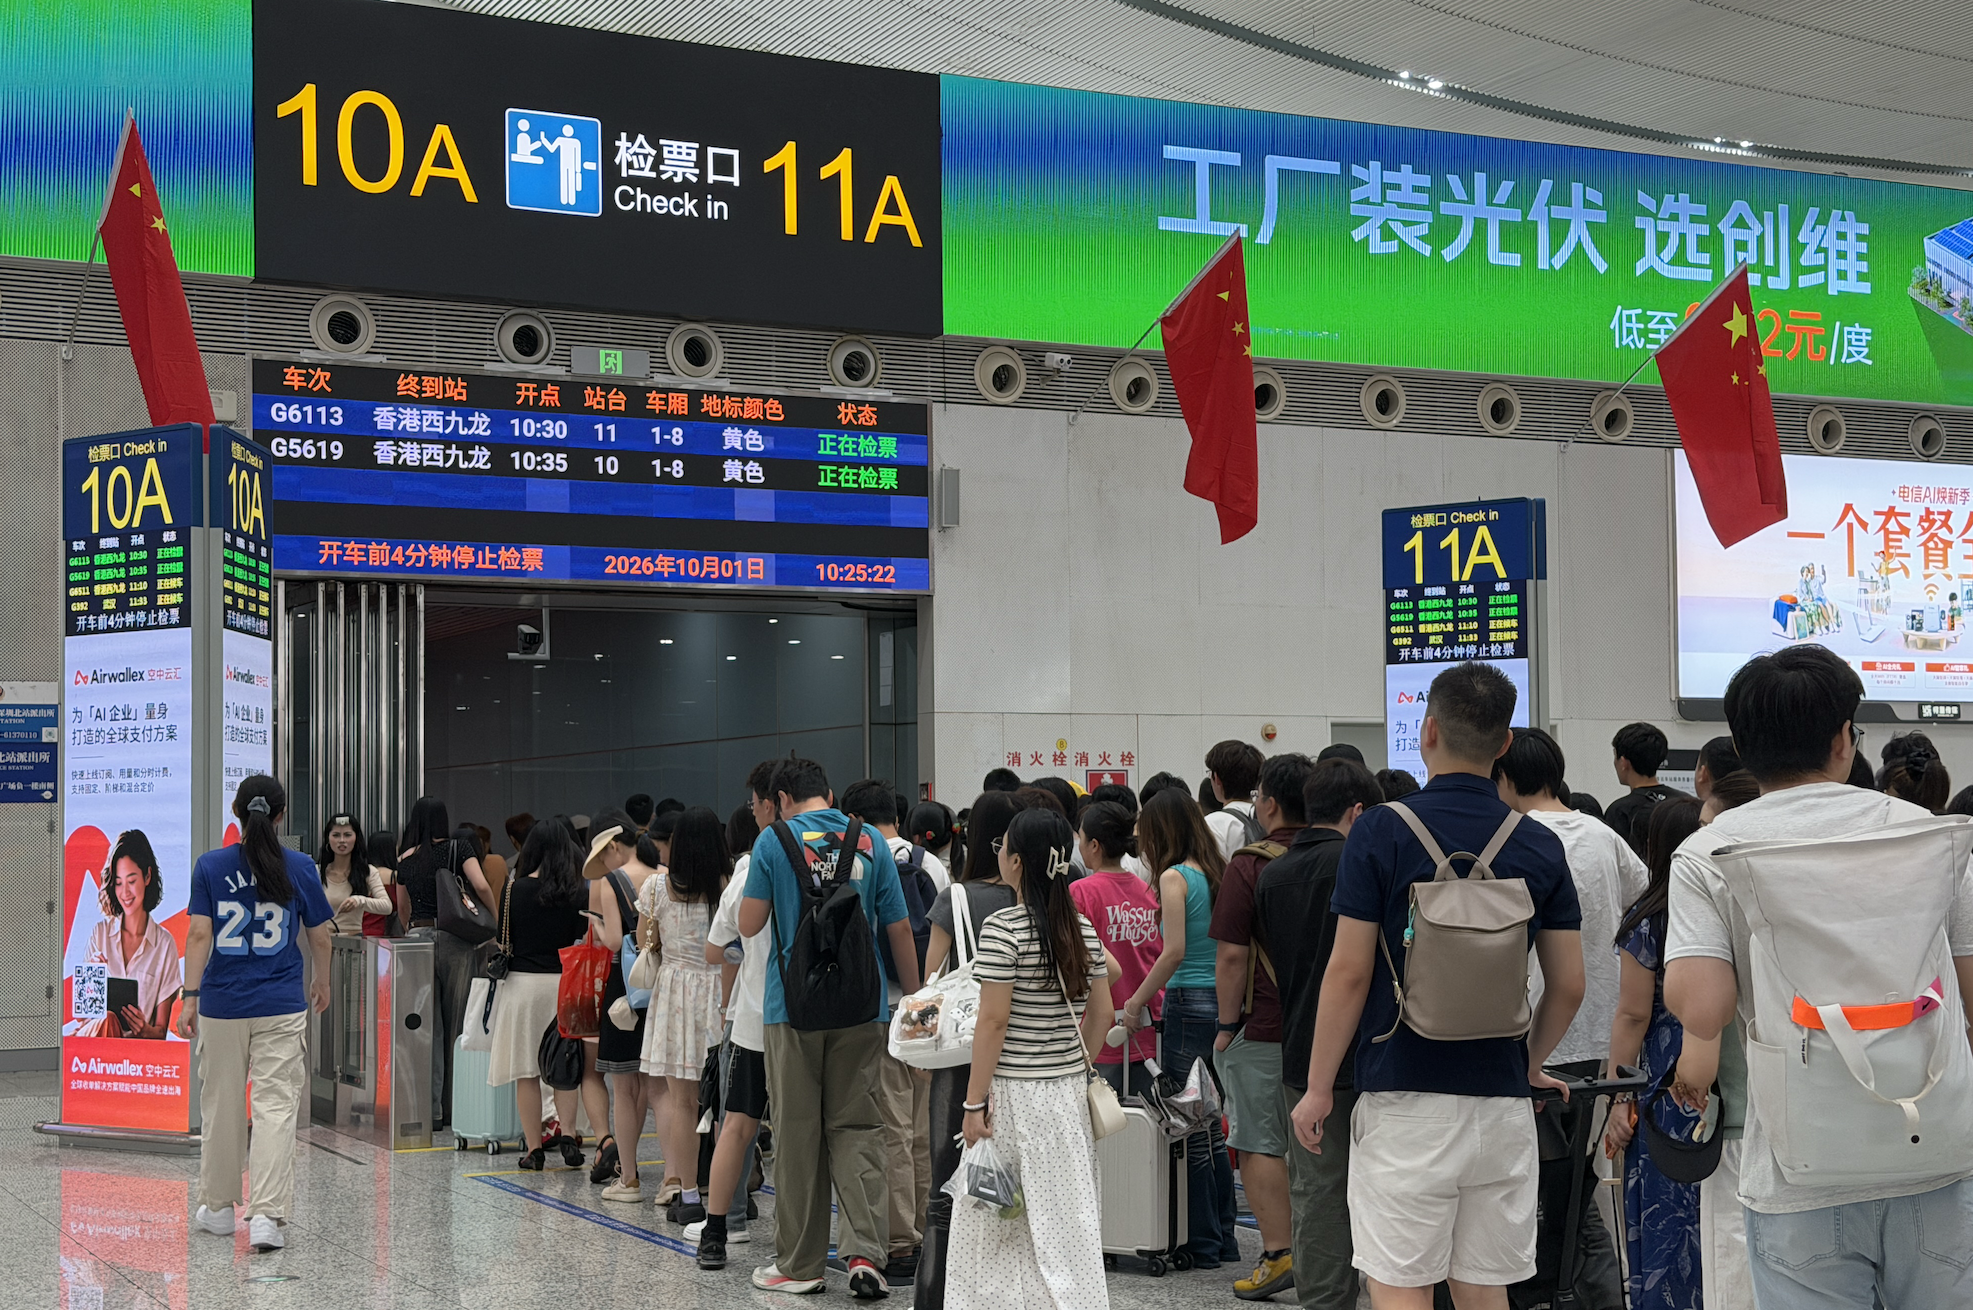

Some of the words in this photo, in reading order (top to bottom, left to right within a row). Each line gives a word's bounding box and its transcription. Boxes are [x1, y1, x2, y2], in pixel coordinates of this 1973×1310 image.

[277, 83, 479, 204] 10A
[614, 132, 740, 186] 检票口
[614, 184, 699, 218] Check
[706, 194, 729, 220] in
[763, 140, 923, 248] 11A
[1158, 143, 1608, 275] 工厂装光伏
[1634, 188, 1873, 297] 选创维
[283, 366, 332, 393] 车次
[397, 374, 468, 401] 终到站
[516, 383, 561, 408] 开点
[584, 386, 627, 412] 站台
[646, 390, 689, 415] 车厢
[700, 394, 785, 421] 地标颜色
[837, 402, 878, 426] 状态
[270, 403, 344, 426] G6113
[373, 406, 492, 437] 香港西九龙
[510, 418, 568, 440] 10:30
[594, 422, 617, 442] 11
[651, 426, 684, 446] 1-8
[722, 427, 764, 452] 黄色
[818, 433, 898, 459] 正在检票
[88, 444, 121, 463] 检票口
[123, 440, 155, 457] Check
[158, 438, 167, 452] in
[271, 437, 344, 460] G5619
[373, 440, 492, 471] 香港西九龙
[510, 451, 568, 473] 10:35
[595, 456, 619, 475] 10
[651, 459, 685, 479] 1-8
[723, 460, 765, 484] 黄色
[818, 465, 898, 490] 正在检票
[82, 457, 174, 534] 10A
[228, 462, 266, 540] 10A
[1411, 513, 1447, 528] 检票口
[1450, 510, 1486, 524] Check
[1489, 509, 1498, 521] in
[72, 541, 86, 551] 车次
[130, 534, 145, 546] 开点
[162, 531, 177, 543] 状态
[129, 551, 148, 561] 10:30
[318, 540, 544, 571] 开车前4分钟停止检票
[604, 553, 765, 579] 2026年10月01日
[816, 563, 896, 583] 10:25:22
[1404, 525, 1507, 584] 11A
[129, 566, 148, 576] 10:35
[129, 581, 148, 591] 11:10
[1459, 584, 1474, 594] 开点
[1495, 582, 1510, 592] 状态
[76, 608, 180, 632] 开车前4分钟停止检票
[1399, 642, 1515, 661] 开车前4分钟停止检票
[90, 667, 145, 685] Airwallex
[147, 667, 182, 681] 空中云汇
[72, 724, 178, 746] 打造的全球支付方案
[1396, 737, 1421, 751] 打造
[811, 862, 837, 871] NORT
[826, 853, 840, 863] TH
[224, 870, 257, 893] JA
[821, 871, 835, 880] FA
[216, 901, 290, 956] 23
[88, 1057, 143, 1077] Airwallex
[145, 1064, 180, 1079] 空中云汇
